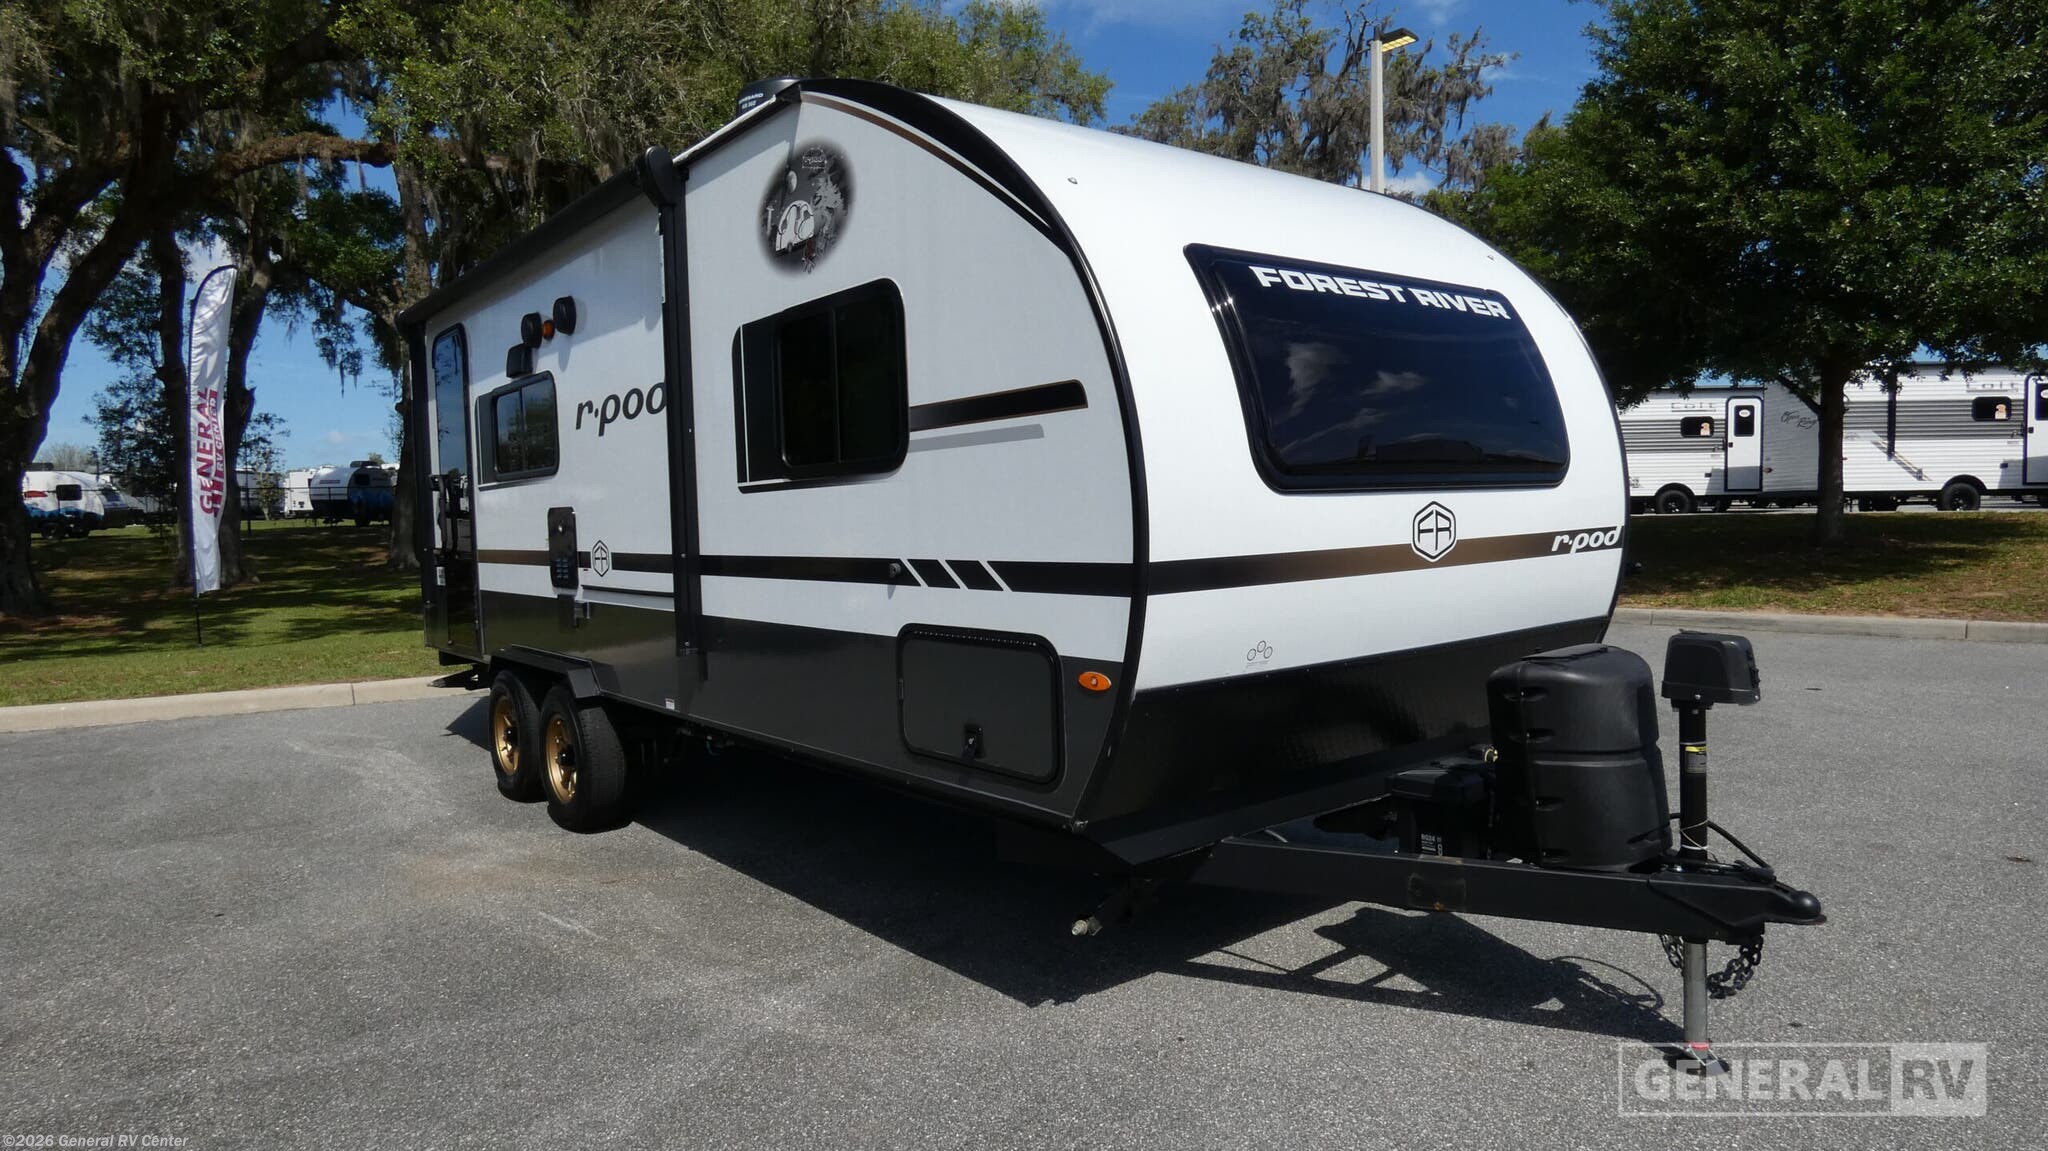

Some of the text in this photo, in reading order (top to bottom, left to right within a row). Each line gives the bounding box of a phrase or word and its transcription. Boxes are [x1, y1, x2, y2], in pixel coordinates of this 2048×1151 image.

[1248, 266, 1511, 320] FOREST RIVER
[196, 387, 214, 515] GENERAL
[215, 452, 225, 471] RV
